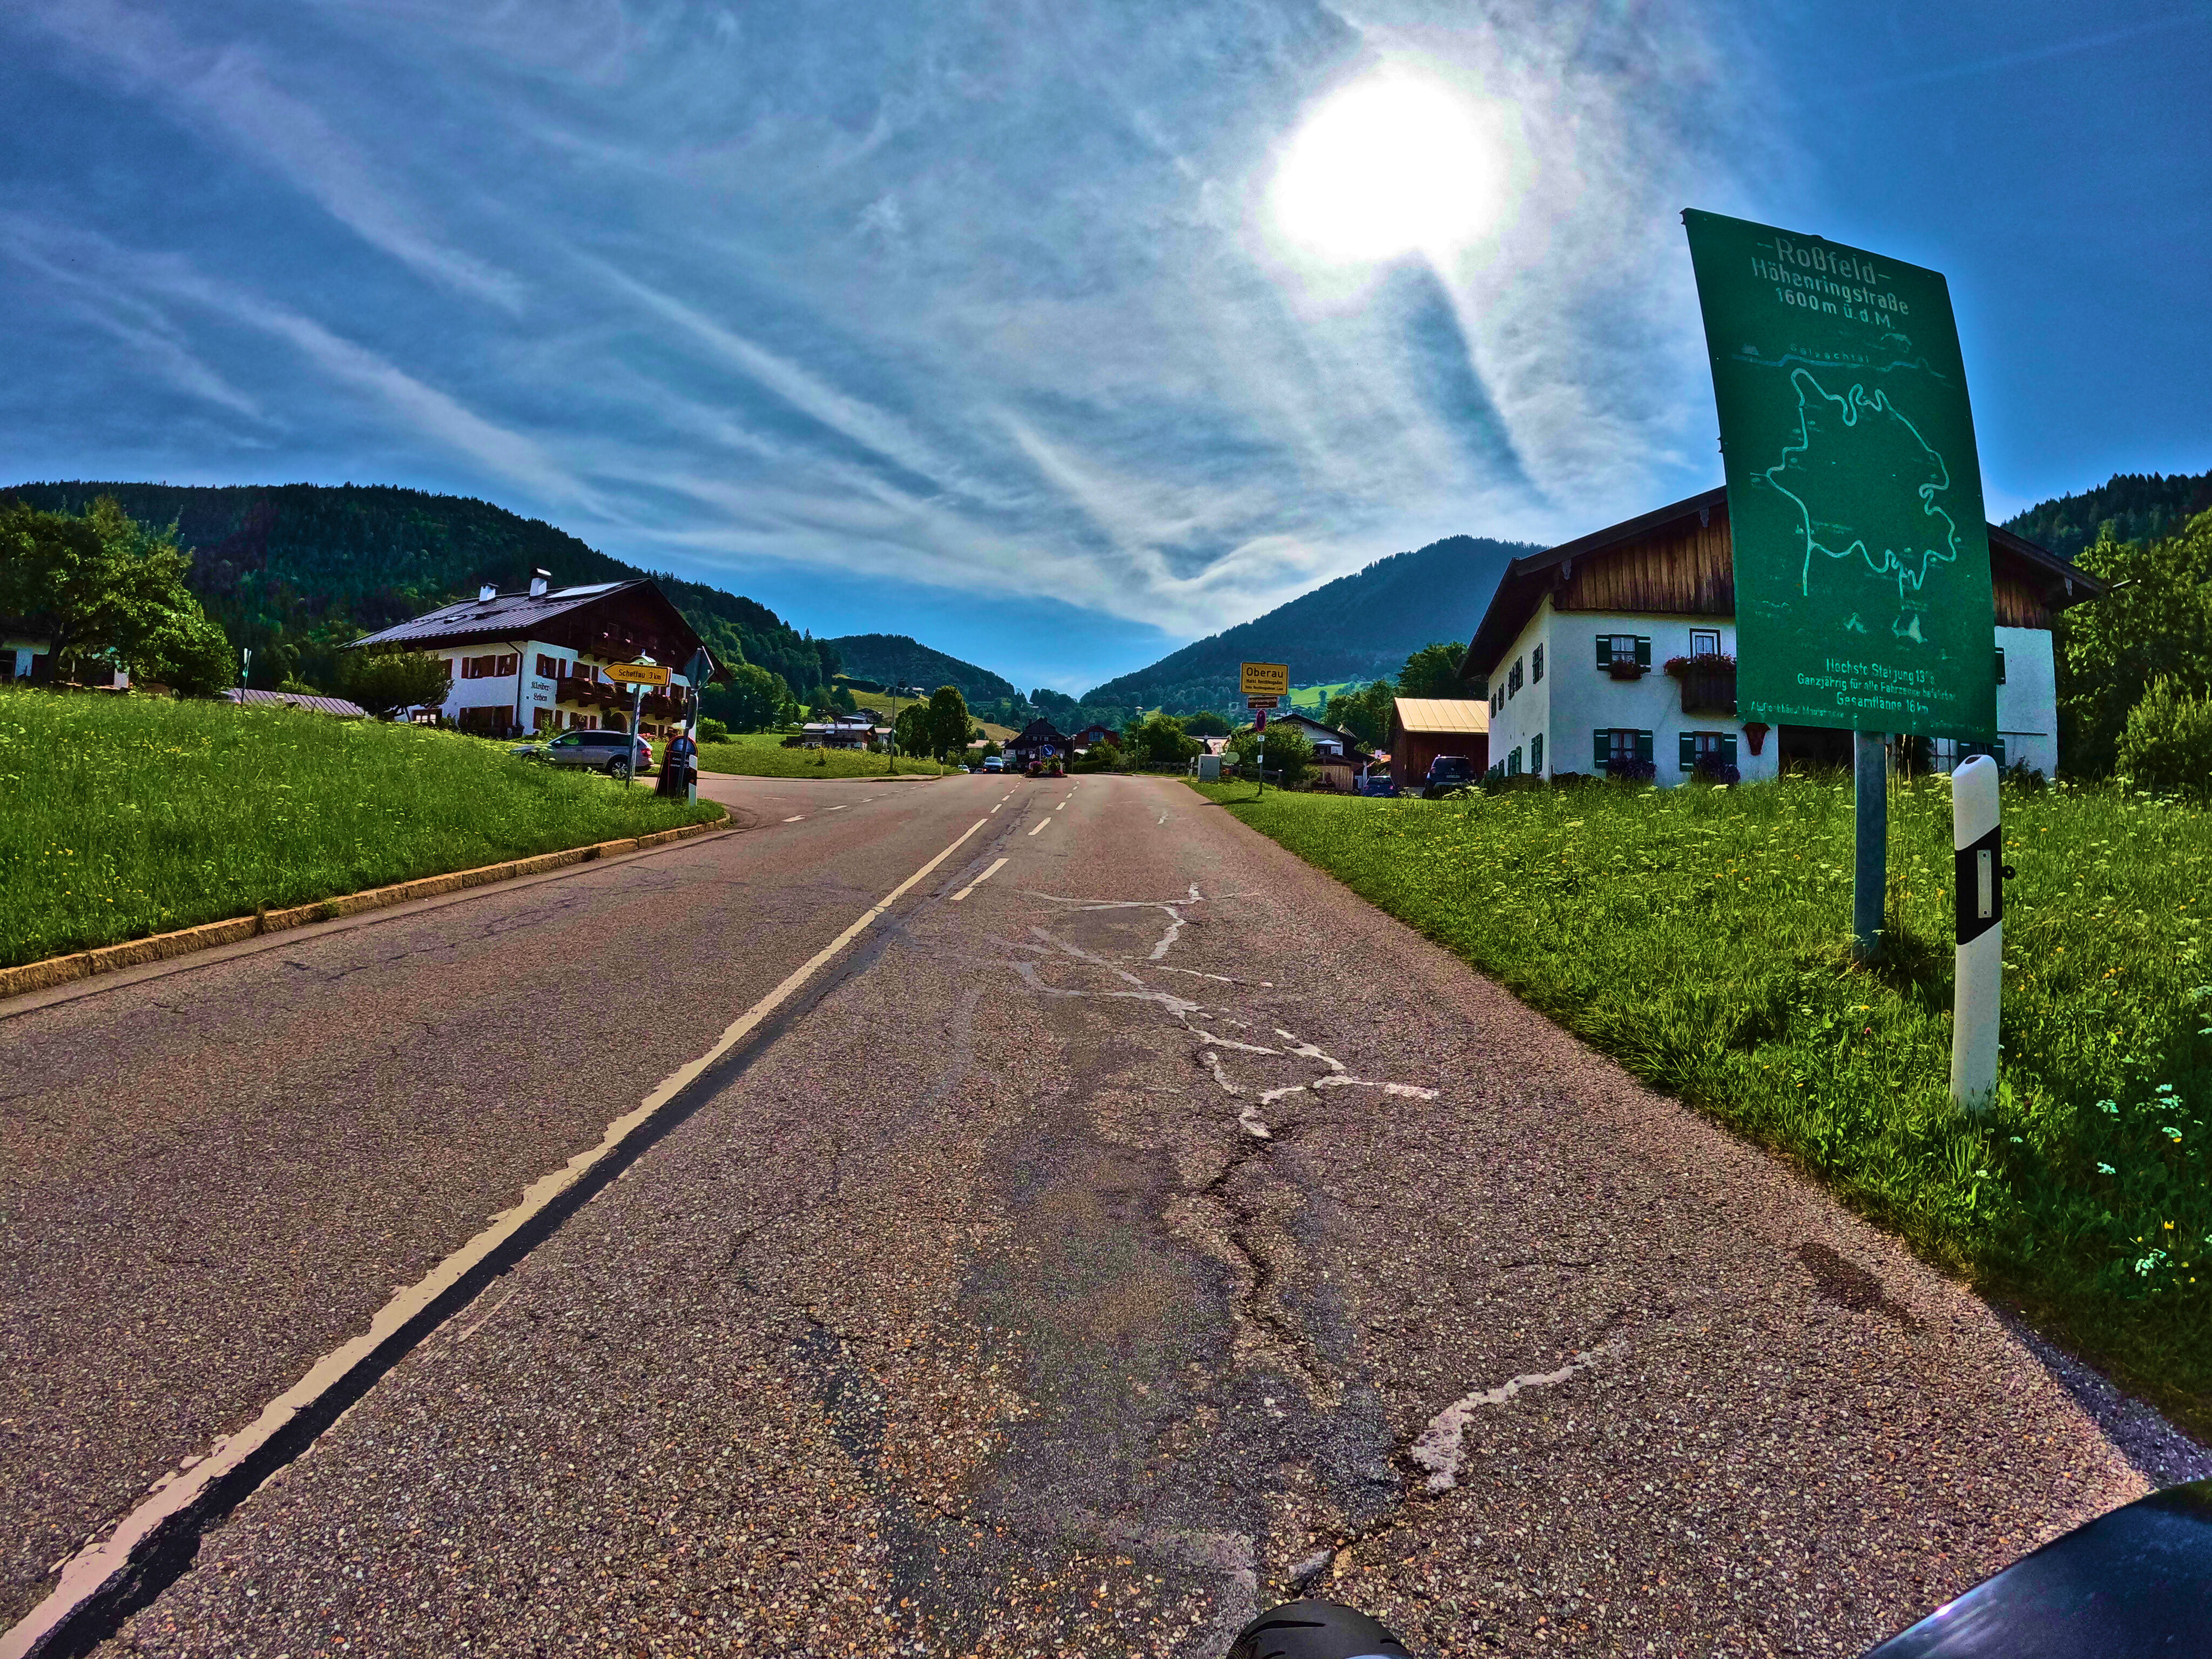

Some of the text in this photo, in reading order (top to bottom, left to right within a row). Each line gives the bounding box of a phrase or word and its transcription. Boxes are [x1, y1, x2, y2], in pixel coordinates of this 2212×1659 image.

[1751, 257, 1909, 315] Höhenringstraße
[1790, 343, 1870, 363] Salzachtal
[618, 669, 645, 678] Scheffau
[1246, 667, 1283, 678] Oberau
[1797, 673, 1847, 691] Ganzjährig
[1850, 678, 1862, 690] für
[1864, 680, 1878, 692] alle
[1872, 663, 1914, 685] Steigung
[1837, 691, 1902, 712] Gesamtlänge
